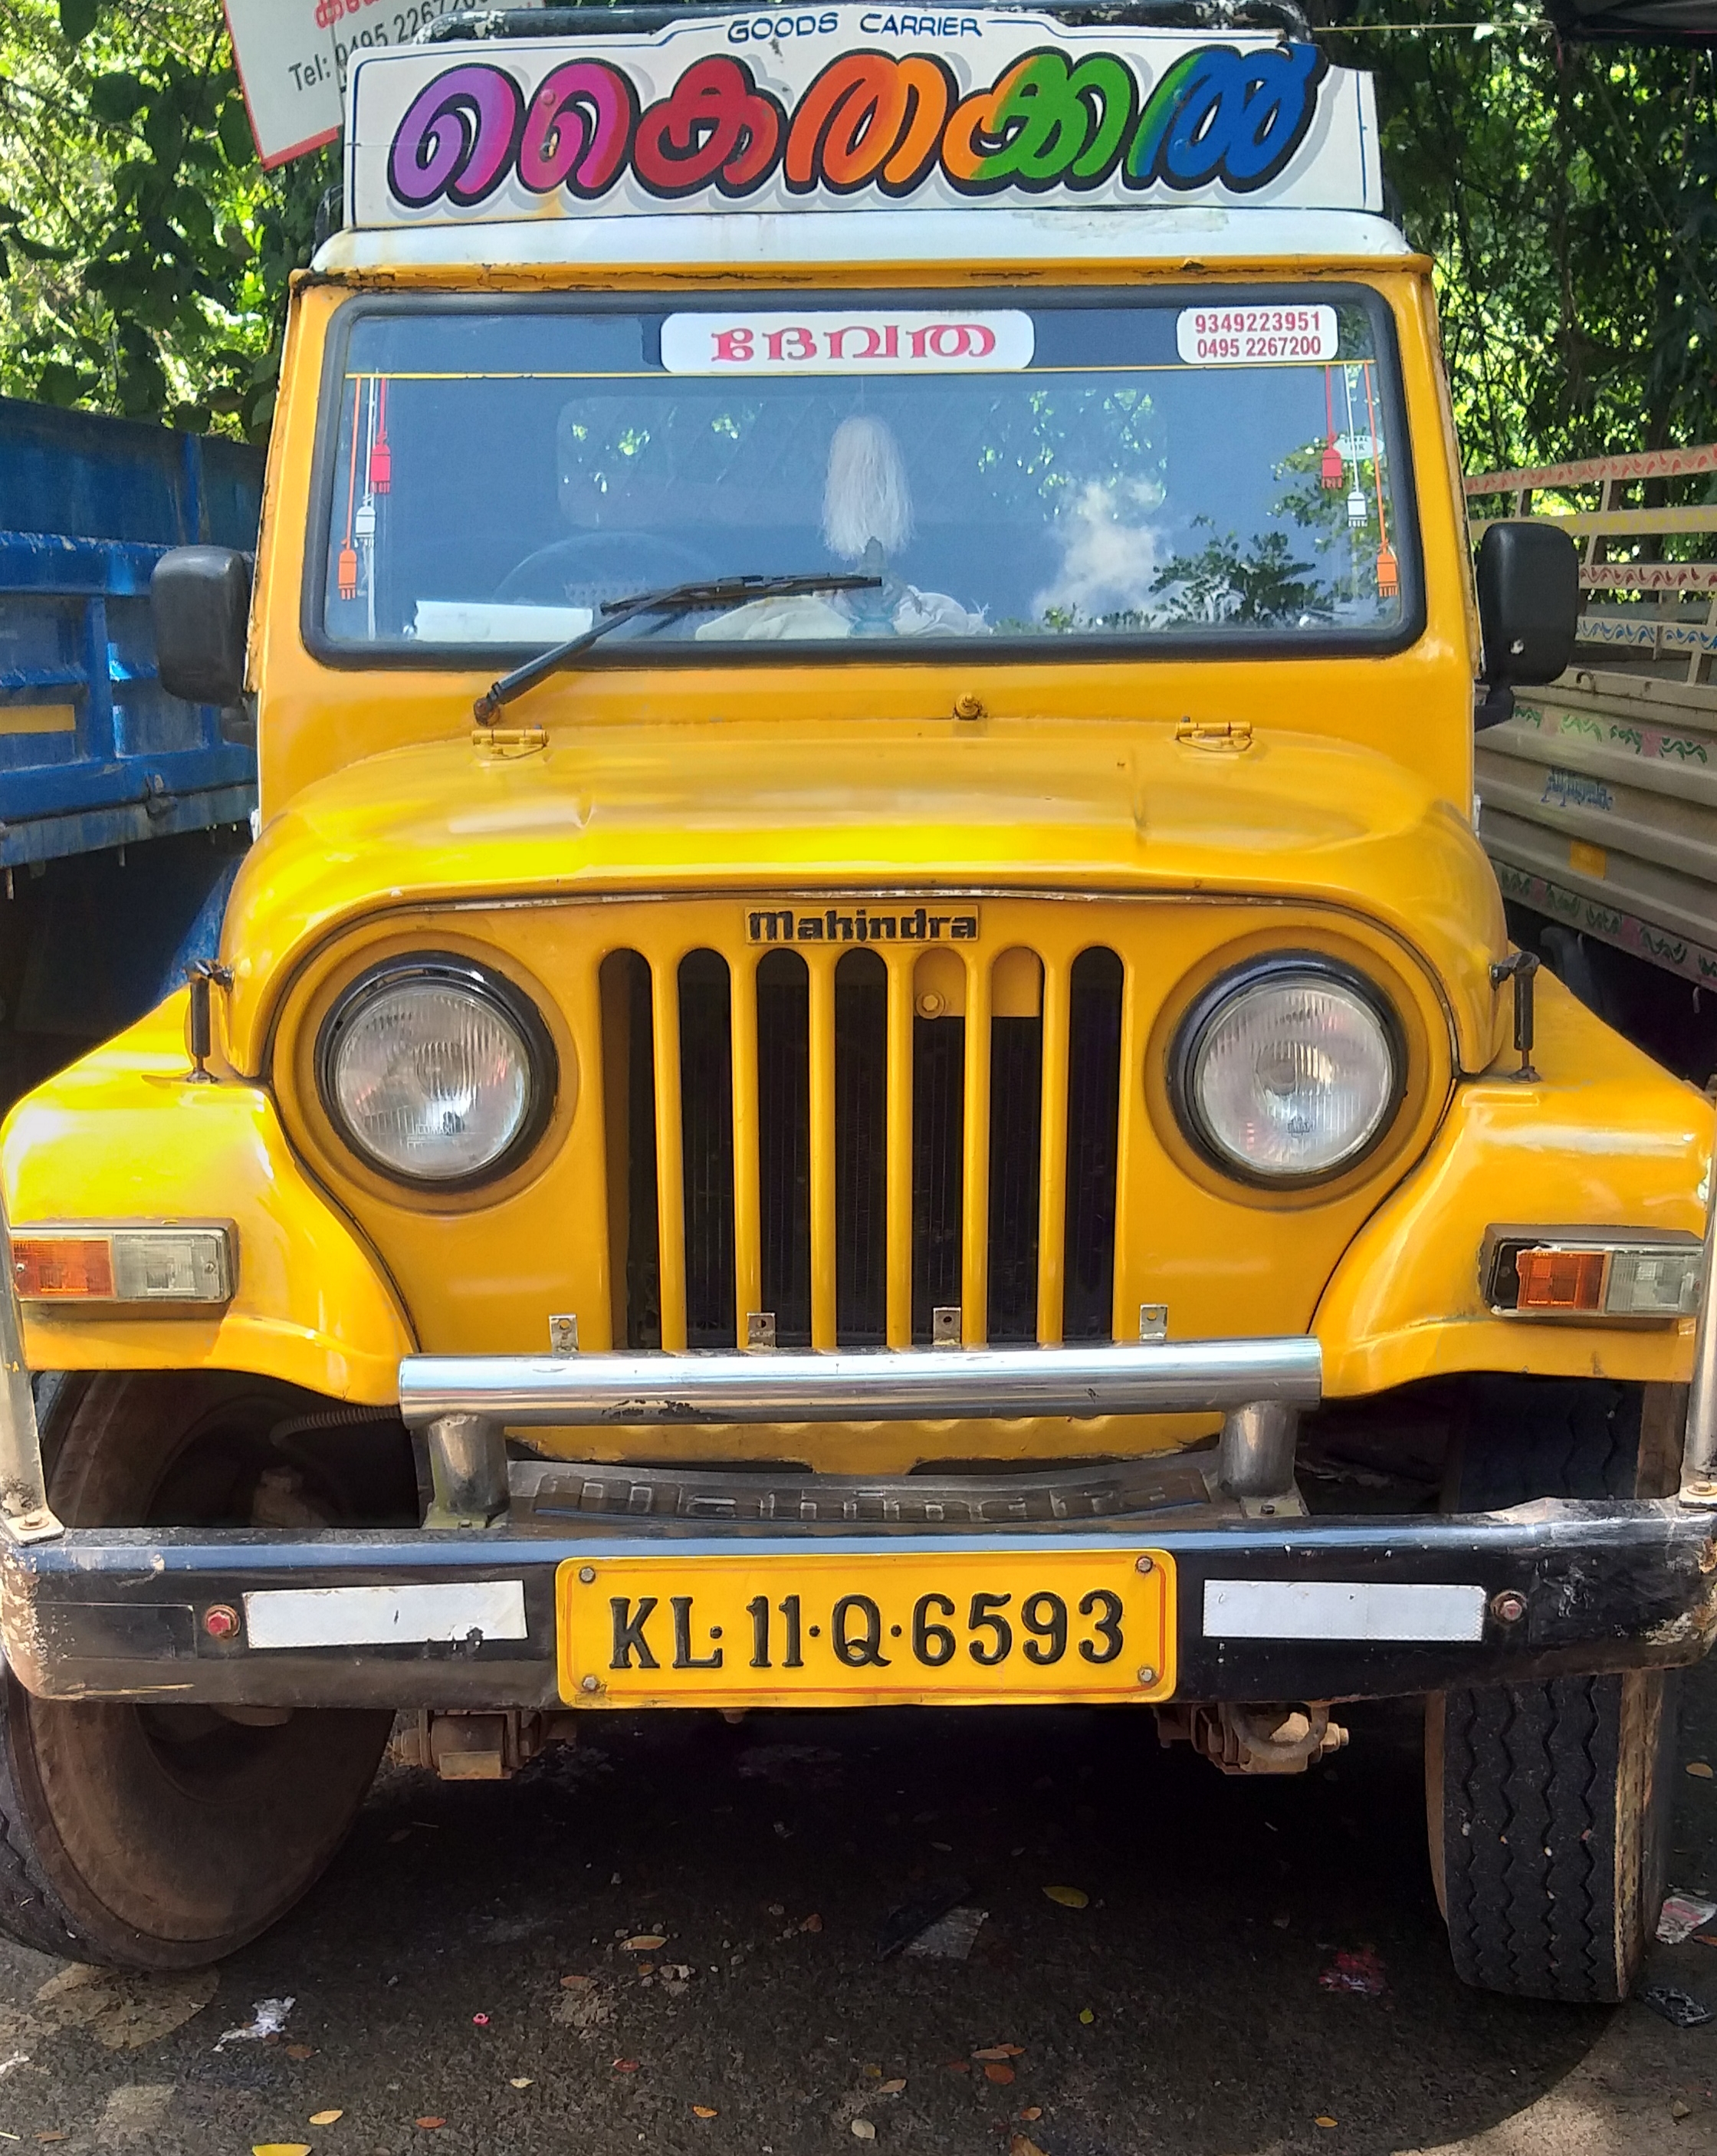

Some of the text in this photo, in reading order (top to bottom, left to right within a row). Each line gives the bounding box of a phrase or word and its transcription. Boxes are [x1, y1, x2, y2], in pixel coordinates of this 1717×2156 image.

[727, 12, 983, 44] GOODS CARRIER
[288, 53, 331, 91] Tel:
[1194, 311, 1320, 334] 9349223951
[1197, 336, 1321, 358] 0495 2267200
